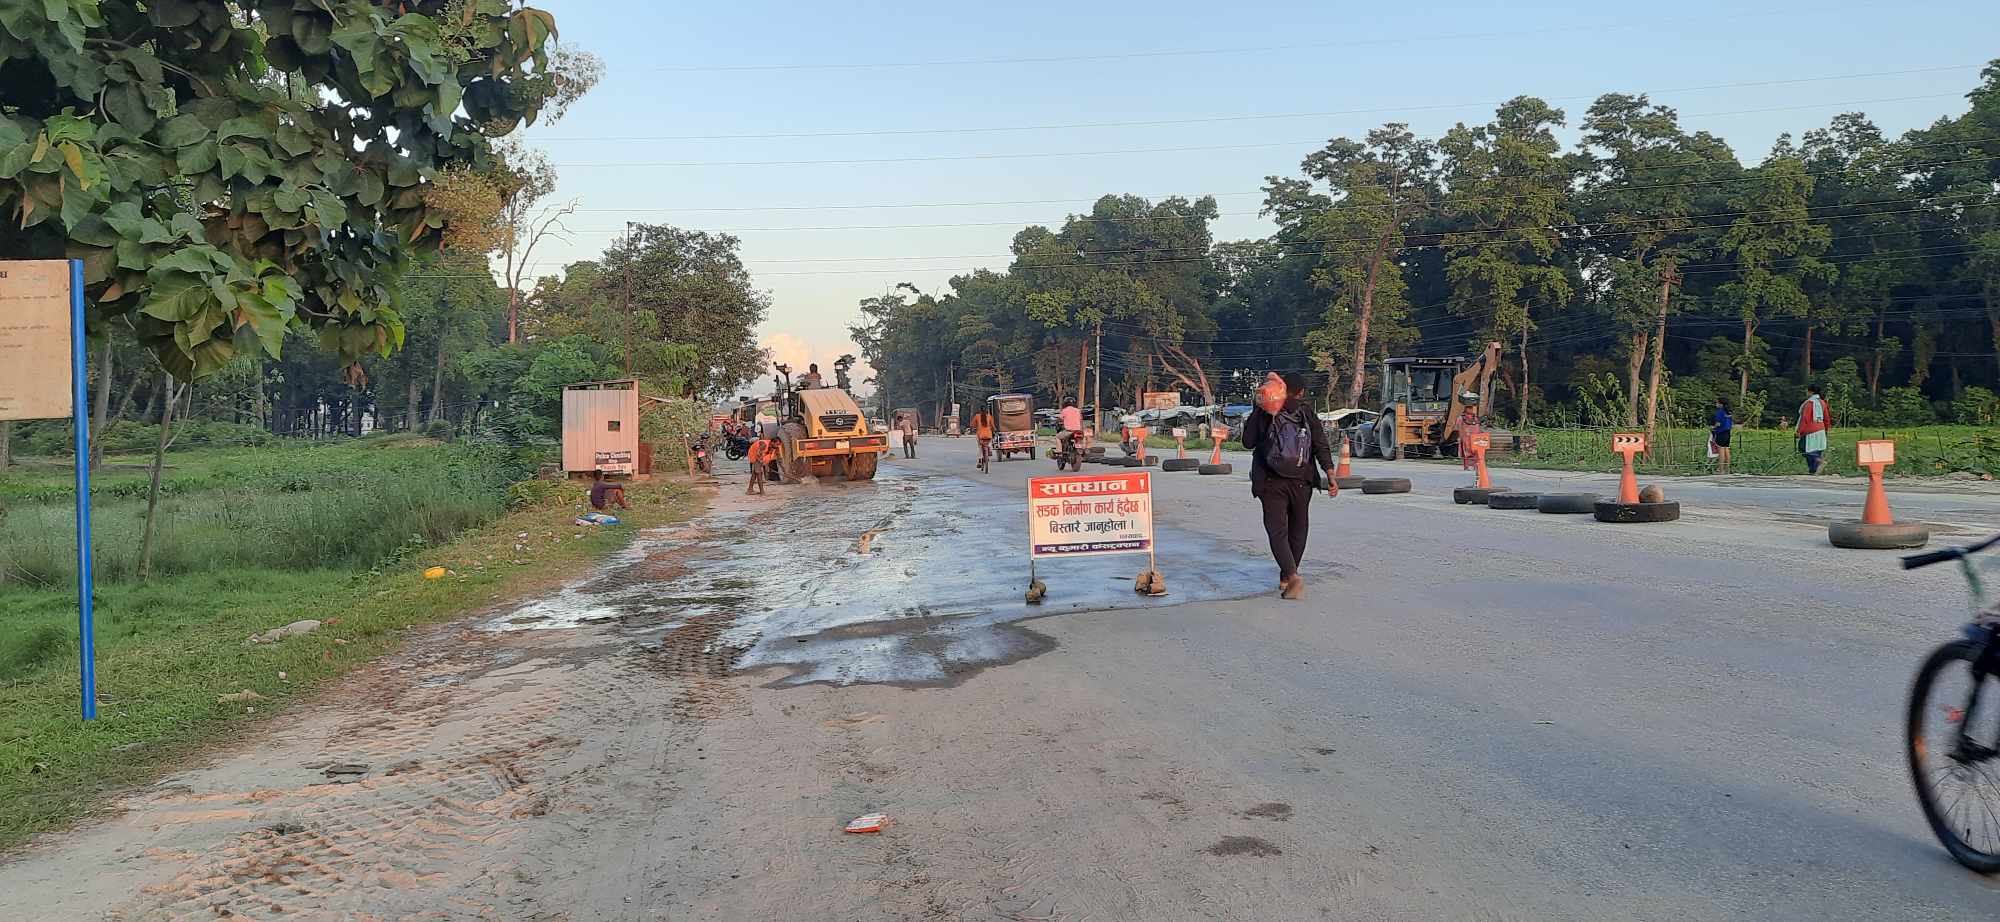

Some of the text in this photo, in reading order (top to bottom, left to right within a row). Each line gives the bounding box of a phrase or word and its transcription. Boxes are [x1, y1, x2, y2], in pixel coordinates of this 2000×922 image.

[1040, 480, 1128, 495] सावधान
[1036, 504, 1060, 518] सडक
[1063, 499, 1092, 516] निर्माण
[1094, 499, 1114, 514] कार्य
[1084, 518, 1127, 534] जानुहोला
